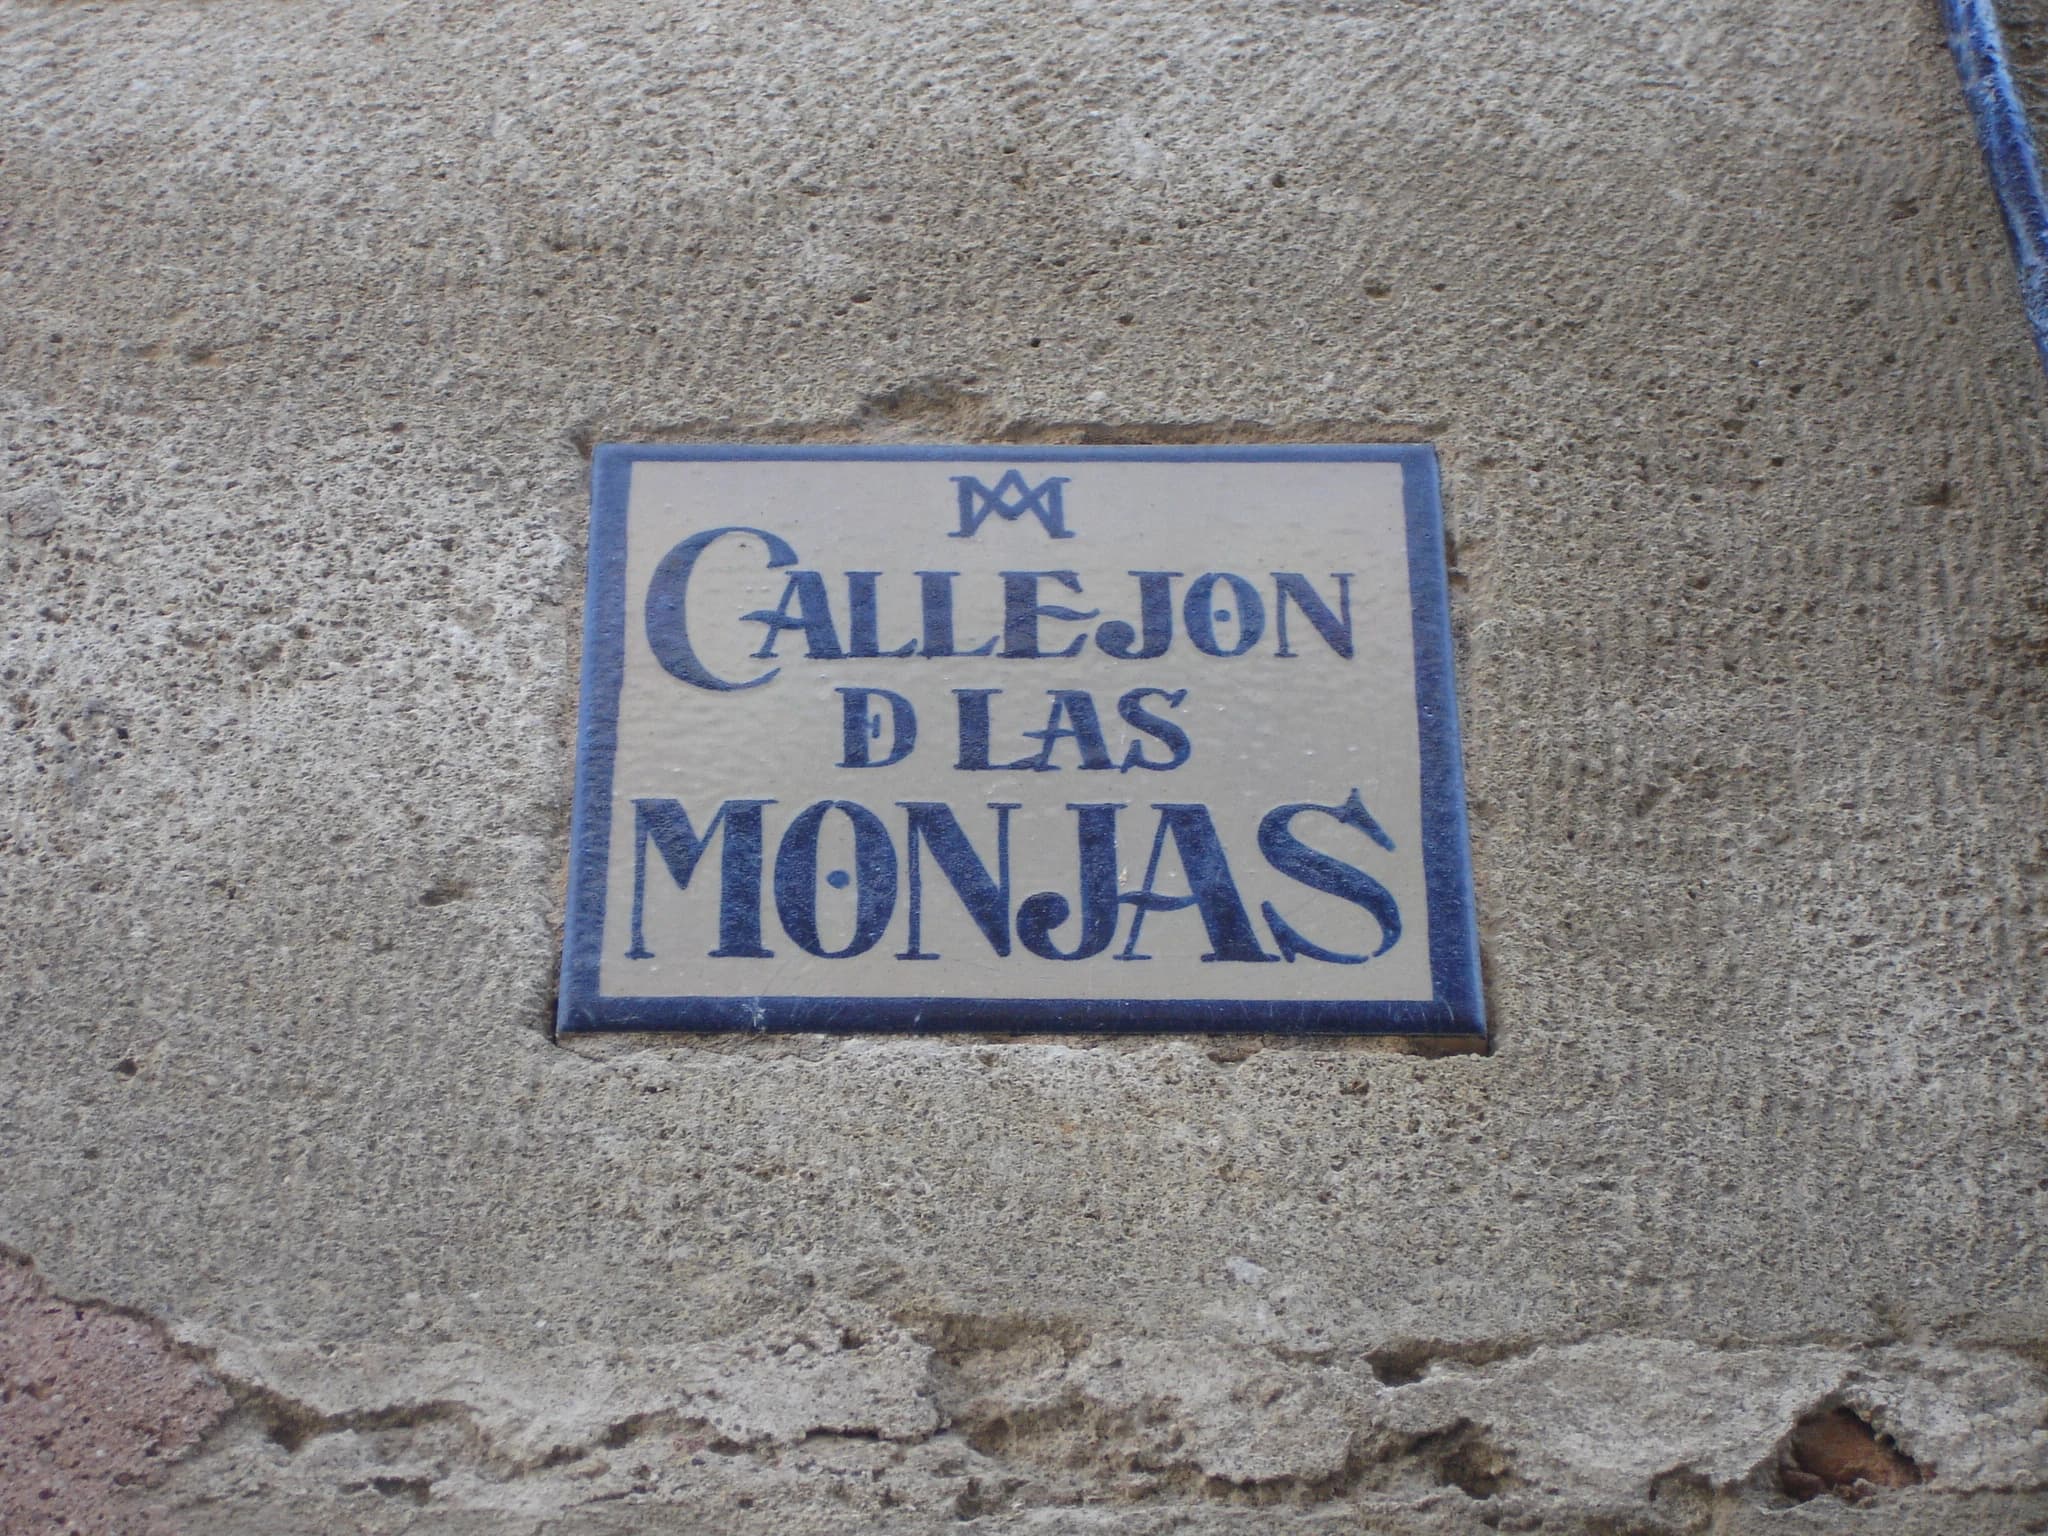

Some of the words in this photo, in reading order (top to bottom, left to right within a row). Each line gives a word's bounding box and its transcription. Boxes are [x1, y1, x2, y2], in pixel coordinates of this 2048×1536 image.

[644, 526, 1355, 693] CALLEJON
[951, 687, 1192, 775] LAS
[623, 787, 1403, 965] MONJAS
